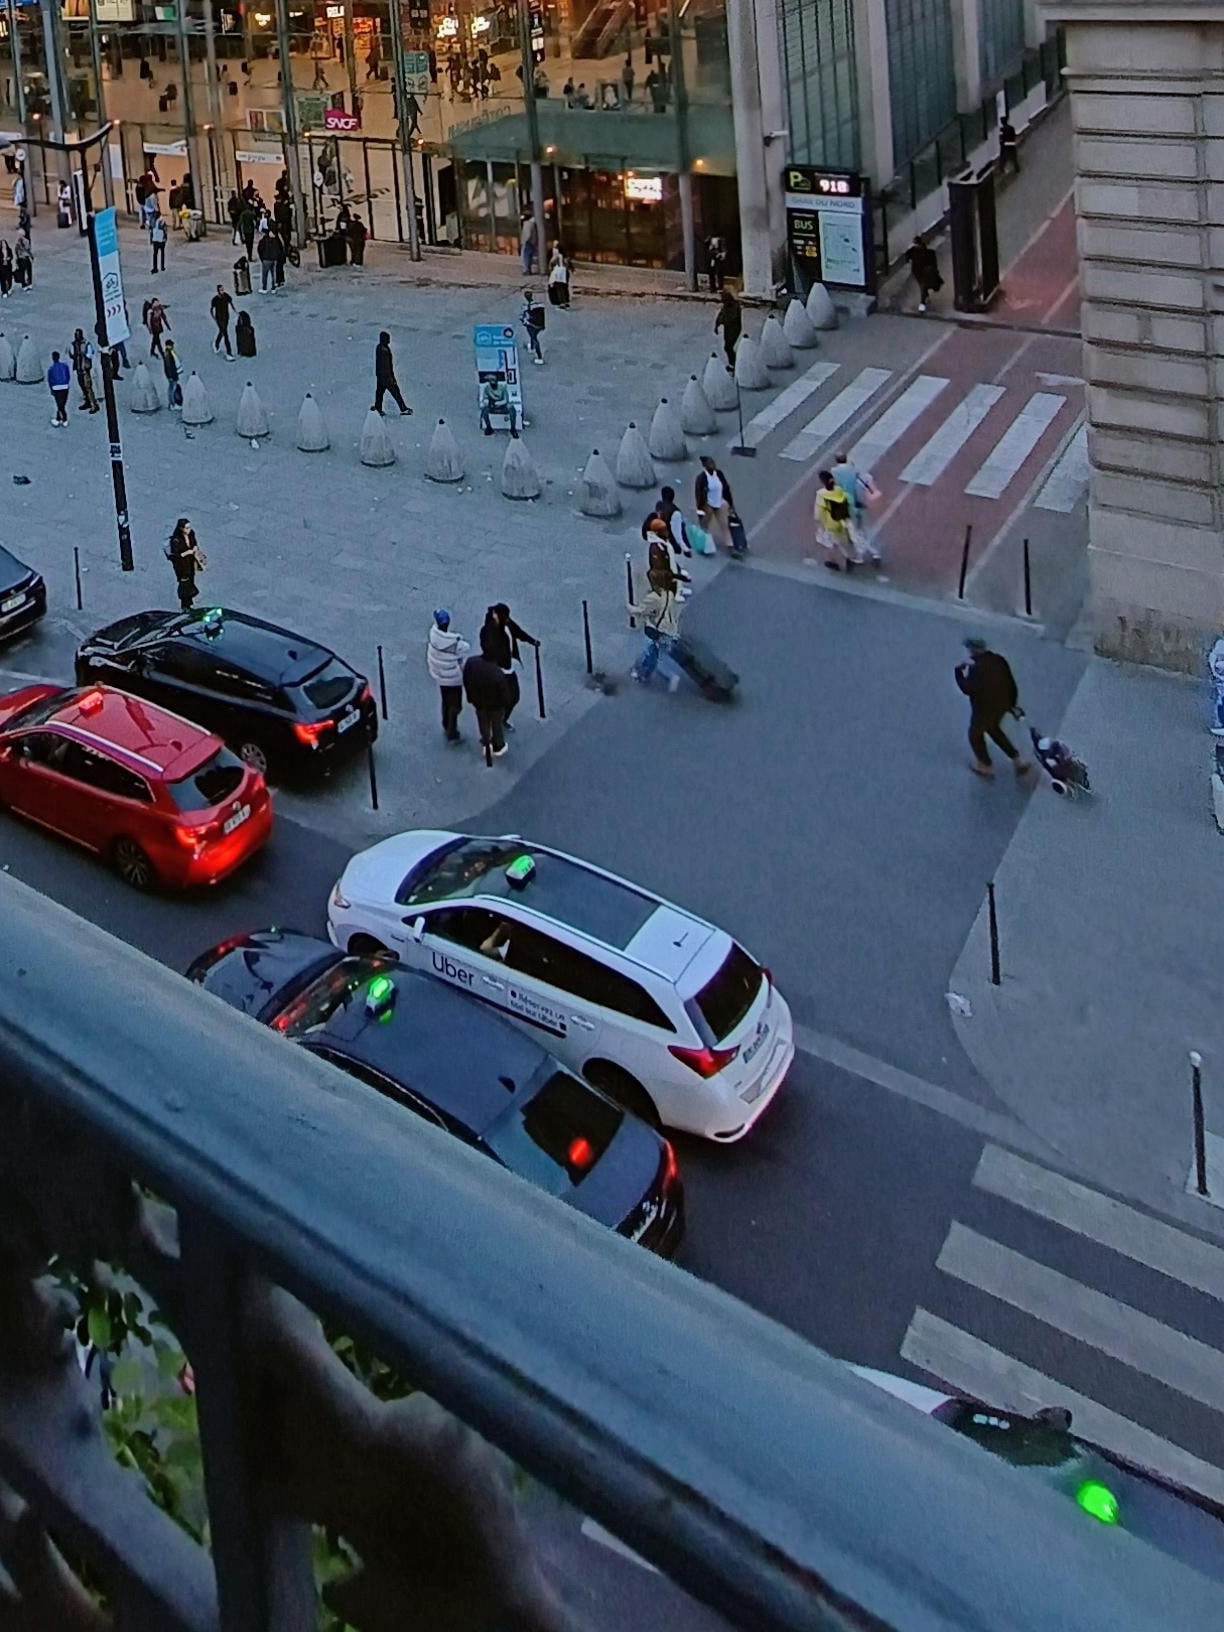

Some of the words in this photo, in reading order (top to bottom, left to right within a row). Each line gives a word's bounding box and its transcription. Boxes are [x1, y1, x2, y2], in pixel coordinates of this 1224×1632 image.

[326, 117, 358, 130] SNCF
[794, 219, 814, 231] BUS
[432, 951, 475, 986] Uber
